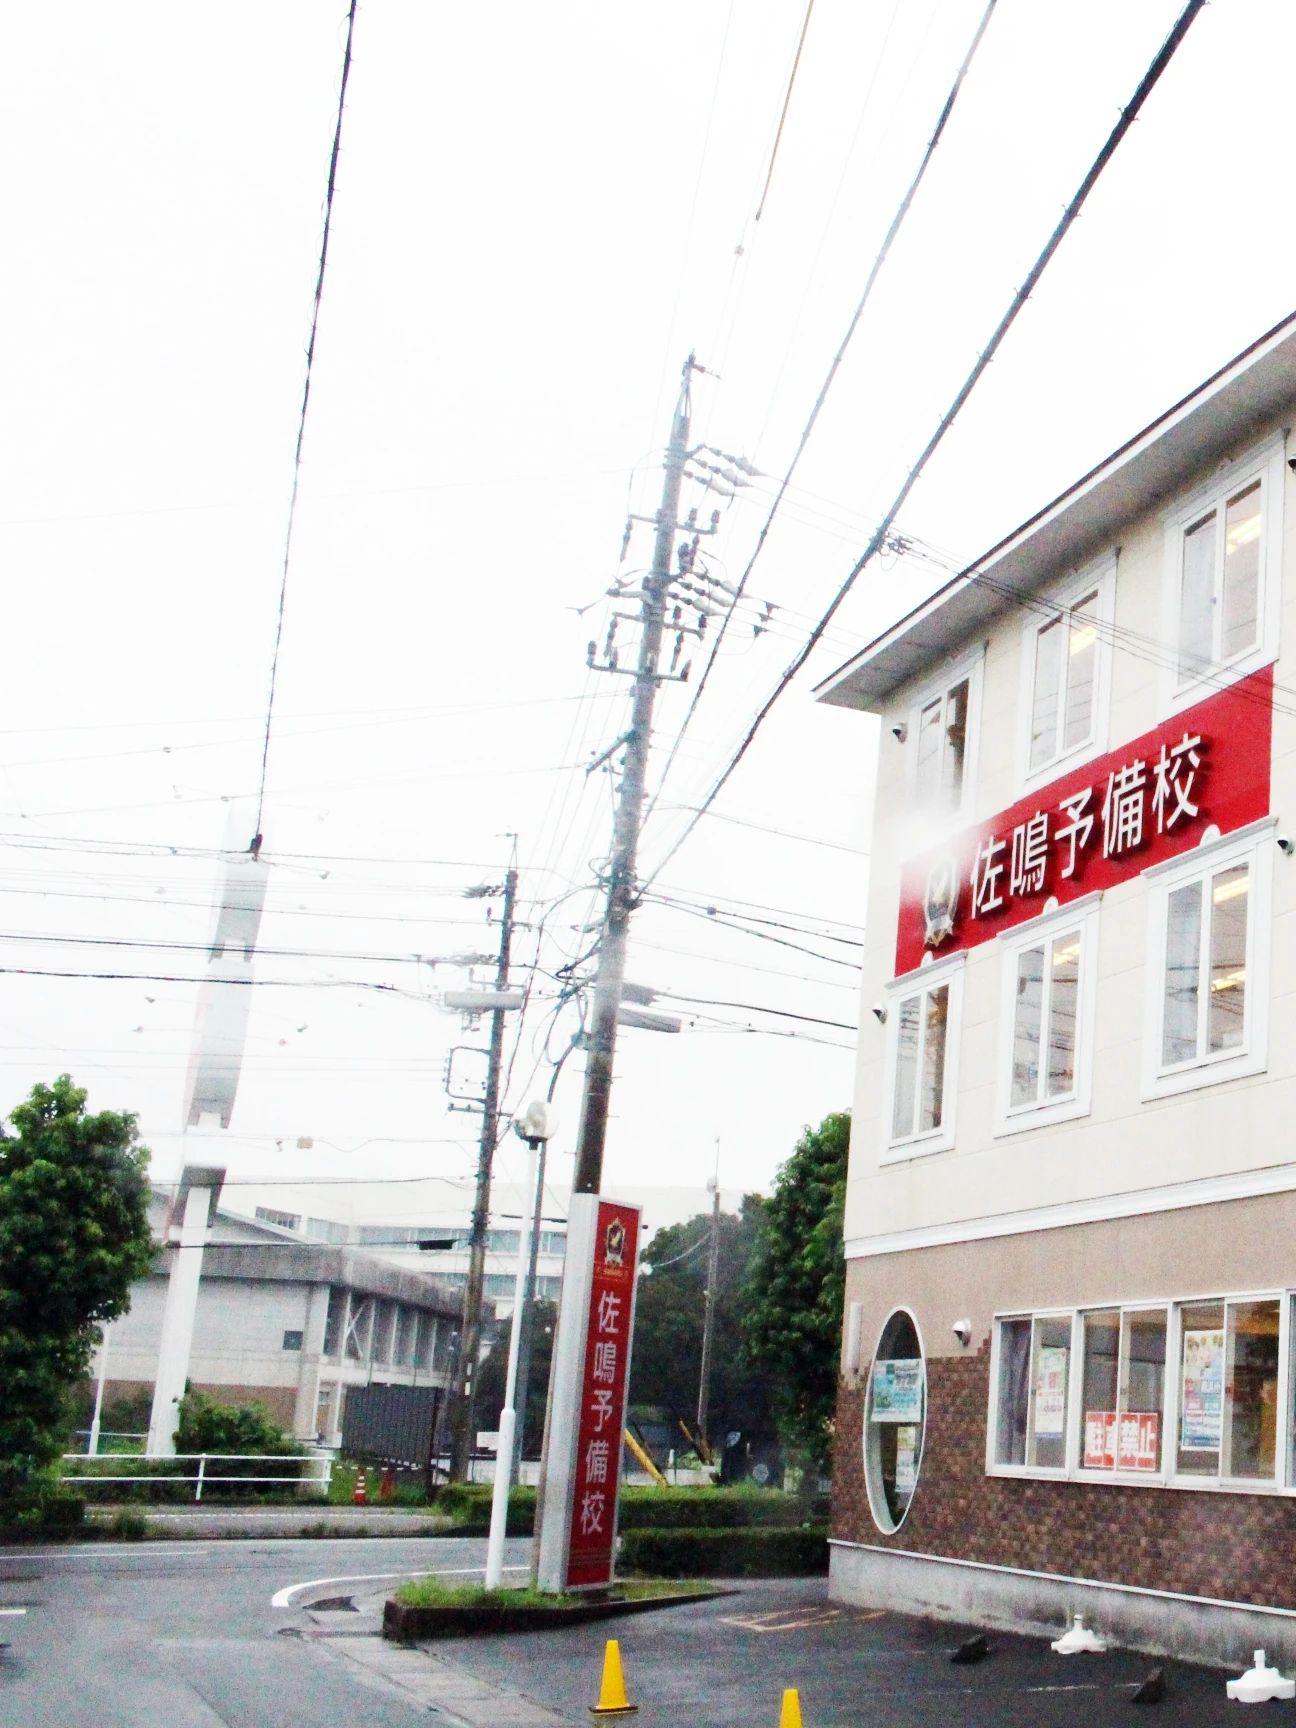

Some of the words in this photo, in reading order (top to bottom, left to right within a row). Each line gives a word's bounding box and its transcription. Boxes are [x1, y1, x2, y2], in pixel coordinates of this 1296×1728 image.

[970, 733, 1201, 919] 佐鳴予備校
[581, 1290, 621, 1535] 佐鳴予備校
